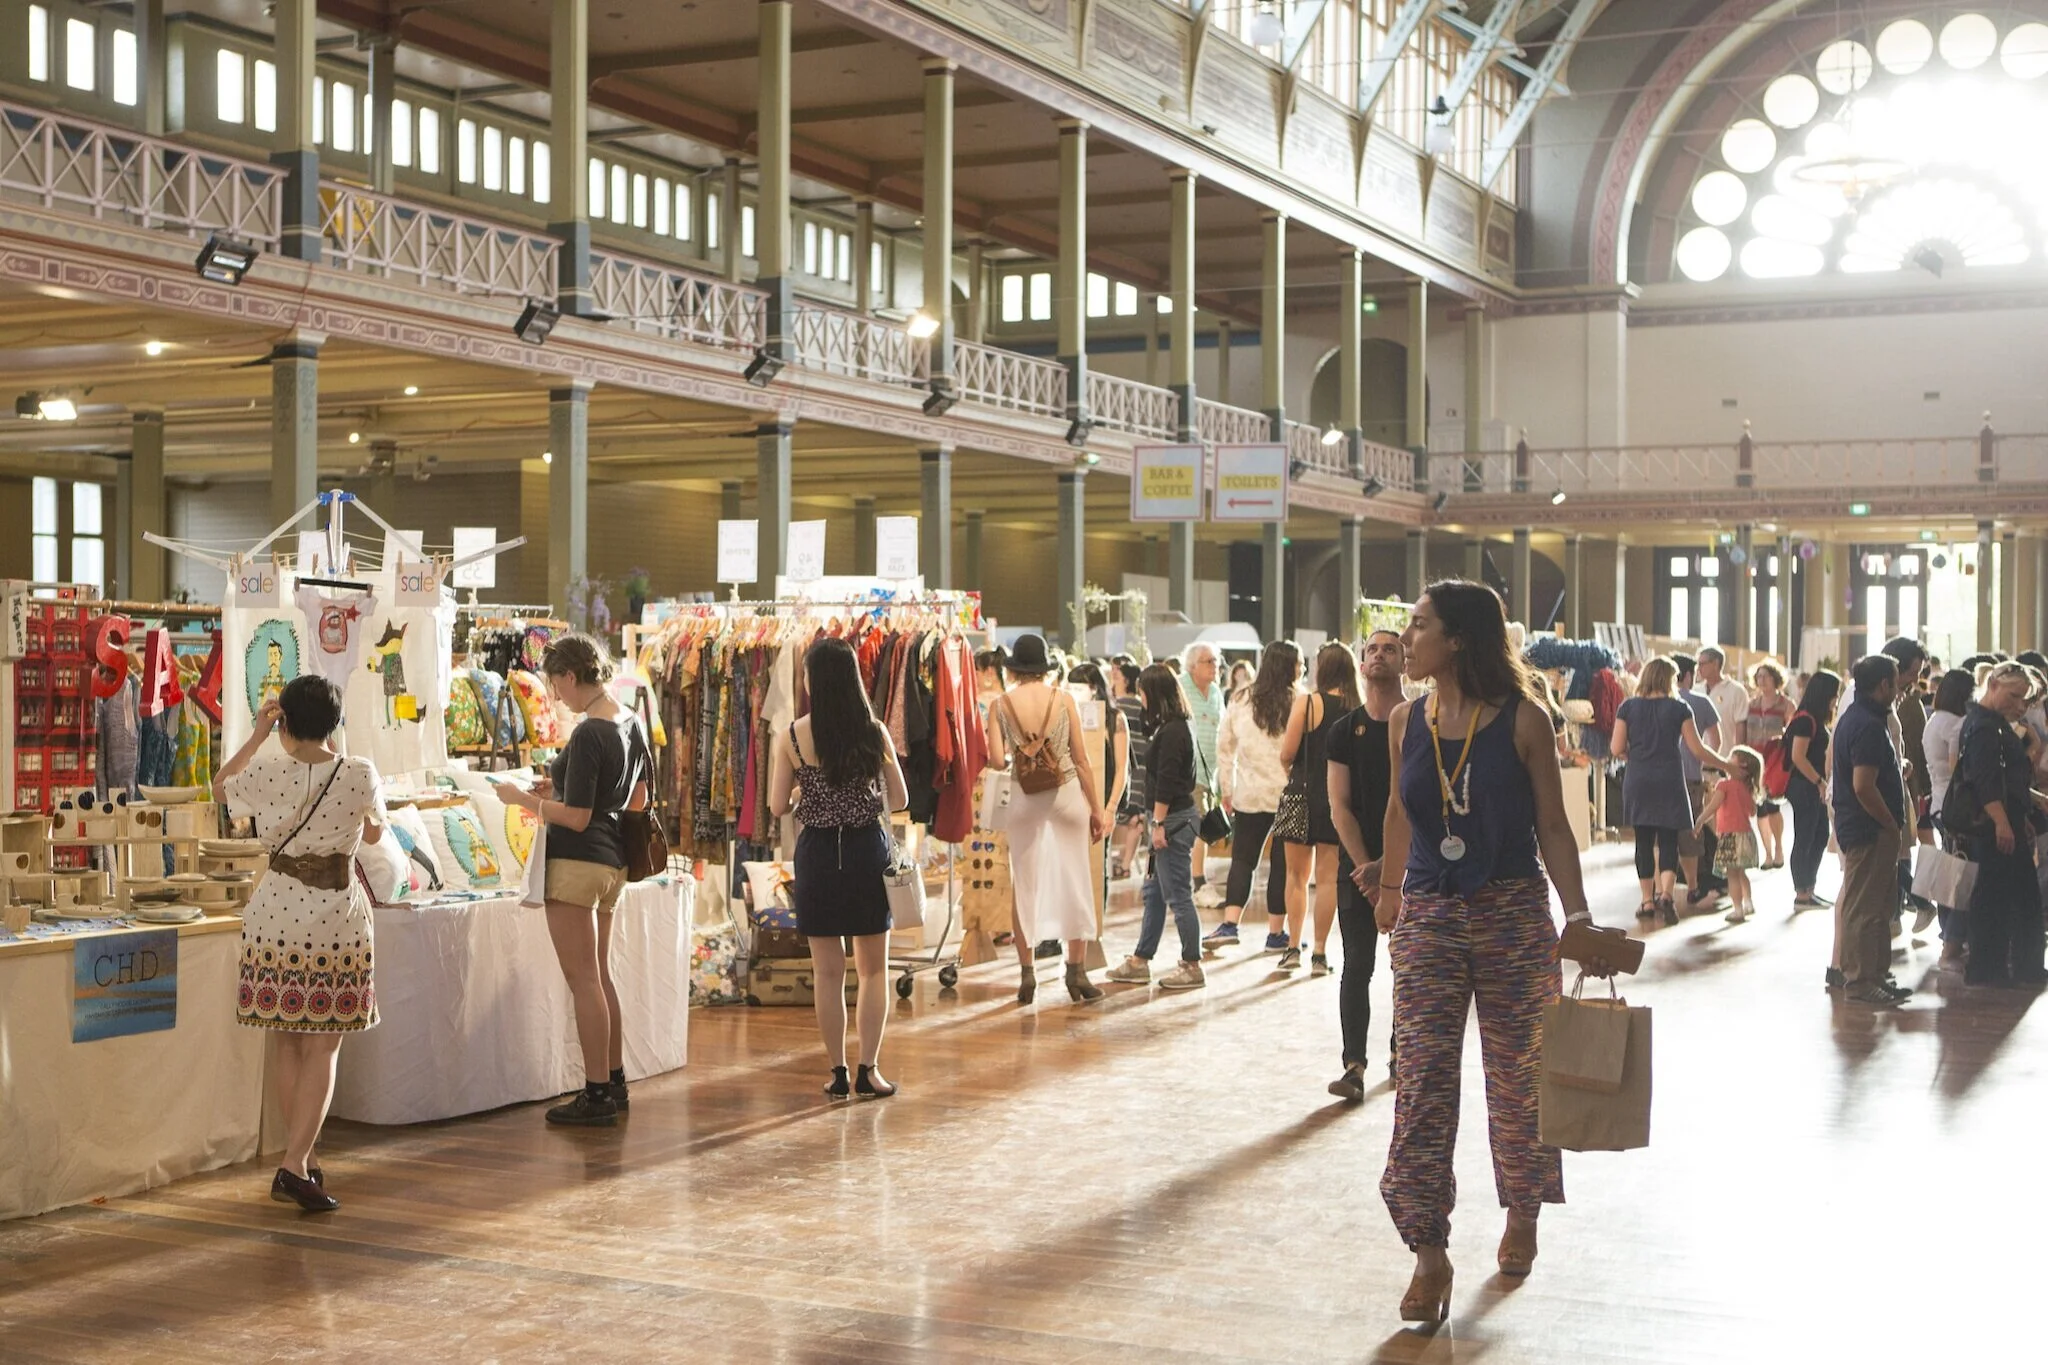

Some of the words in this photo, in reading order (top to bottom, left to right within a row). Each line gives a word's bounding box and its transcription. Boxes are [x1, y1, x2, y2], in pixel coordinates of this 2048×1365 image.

[1149, 468, 1173, 480] BAR
[1224, 475, 1278, 488] TOILETS
[1143, 484, 1193, 497] COFFEE
[240, 571, 274, 595] sale
[400, 570, 435, 594] sale
[94, 950, 159, 988] CHD
